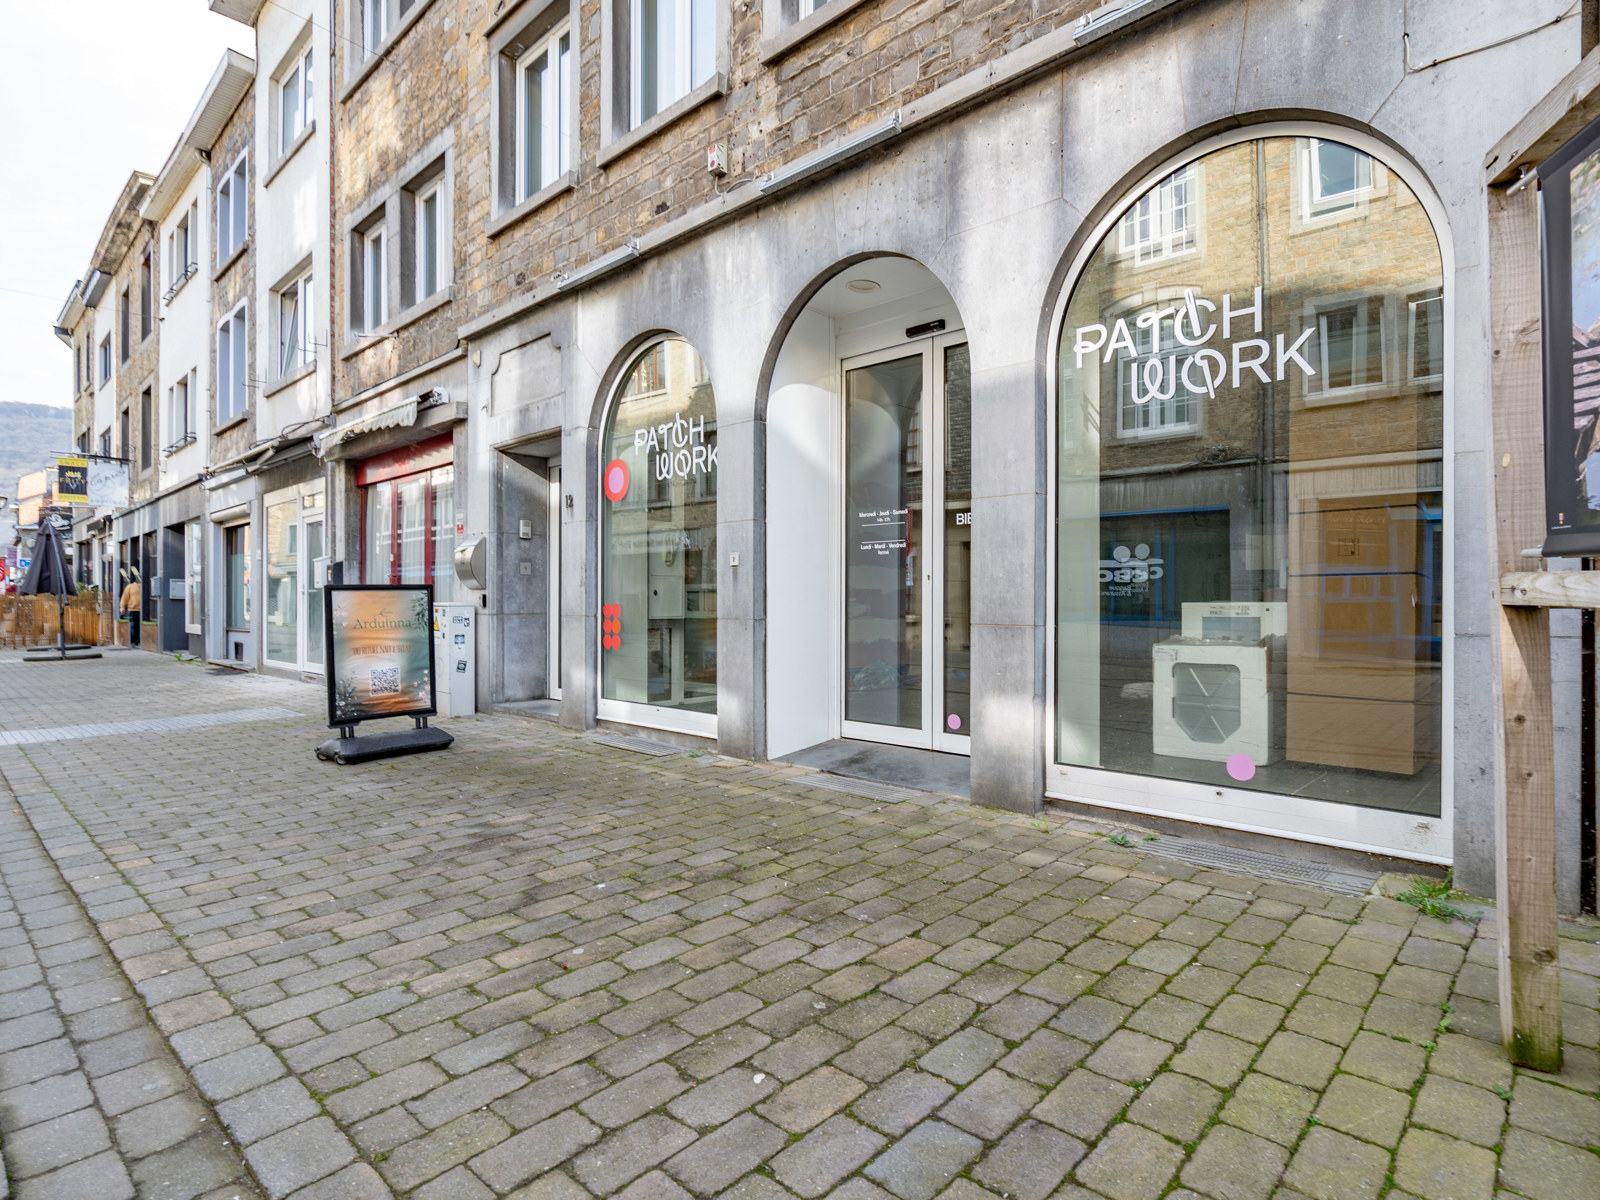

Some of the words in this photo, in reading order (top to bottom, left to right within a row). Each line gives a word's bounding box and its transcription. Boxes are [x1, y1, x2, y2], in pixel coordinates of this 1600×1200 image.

[1073, 285, 1263, 369] PATCH
[1131, 327, 1317, 404] WORK
[634, 412, 704, 456] PATCH
[656, 444, 718, 480] WORK
[565, 494, 574, 508] 12
[353, 617, 412, 630] Arduinna
